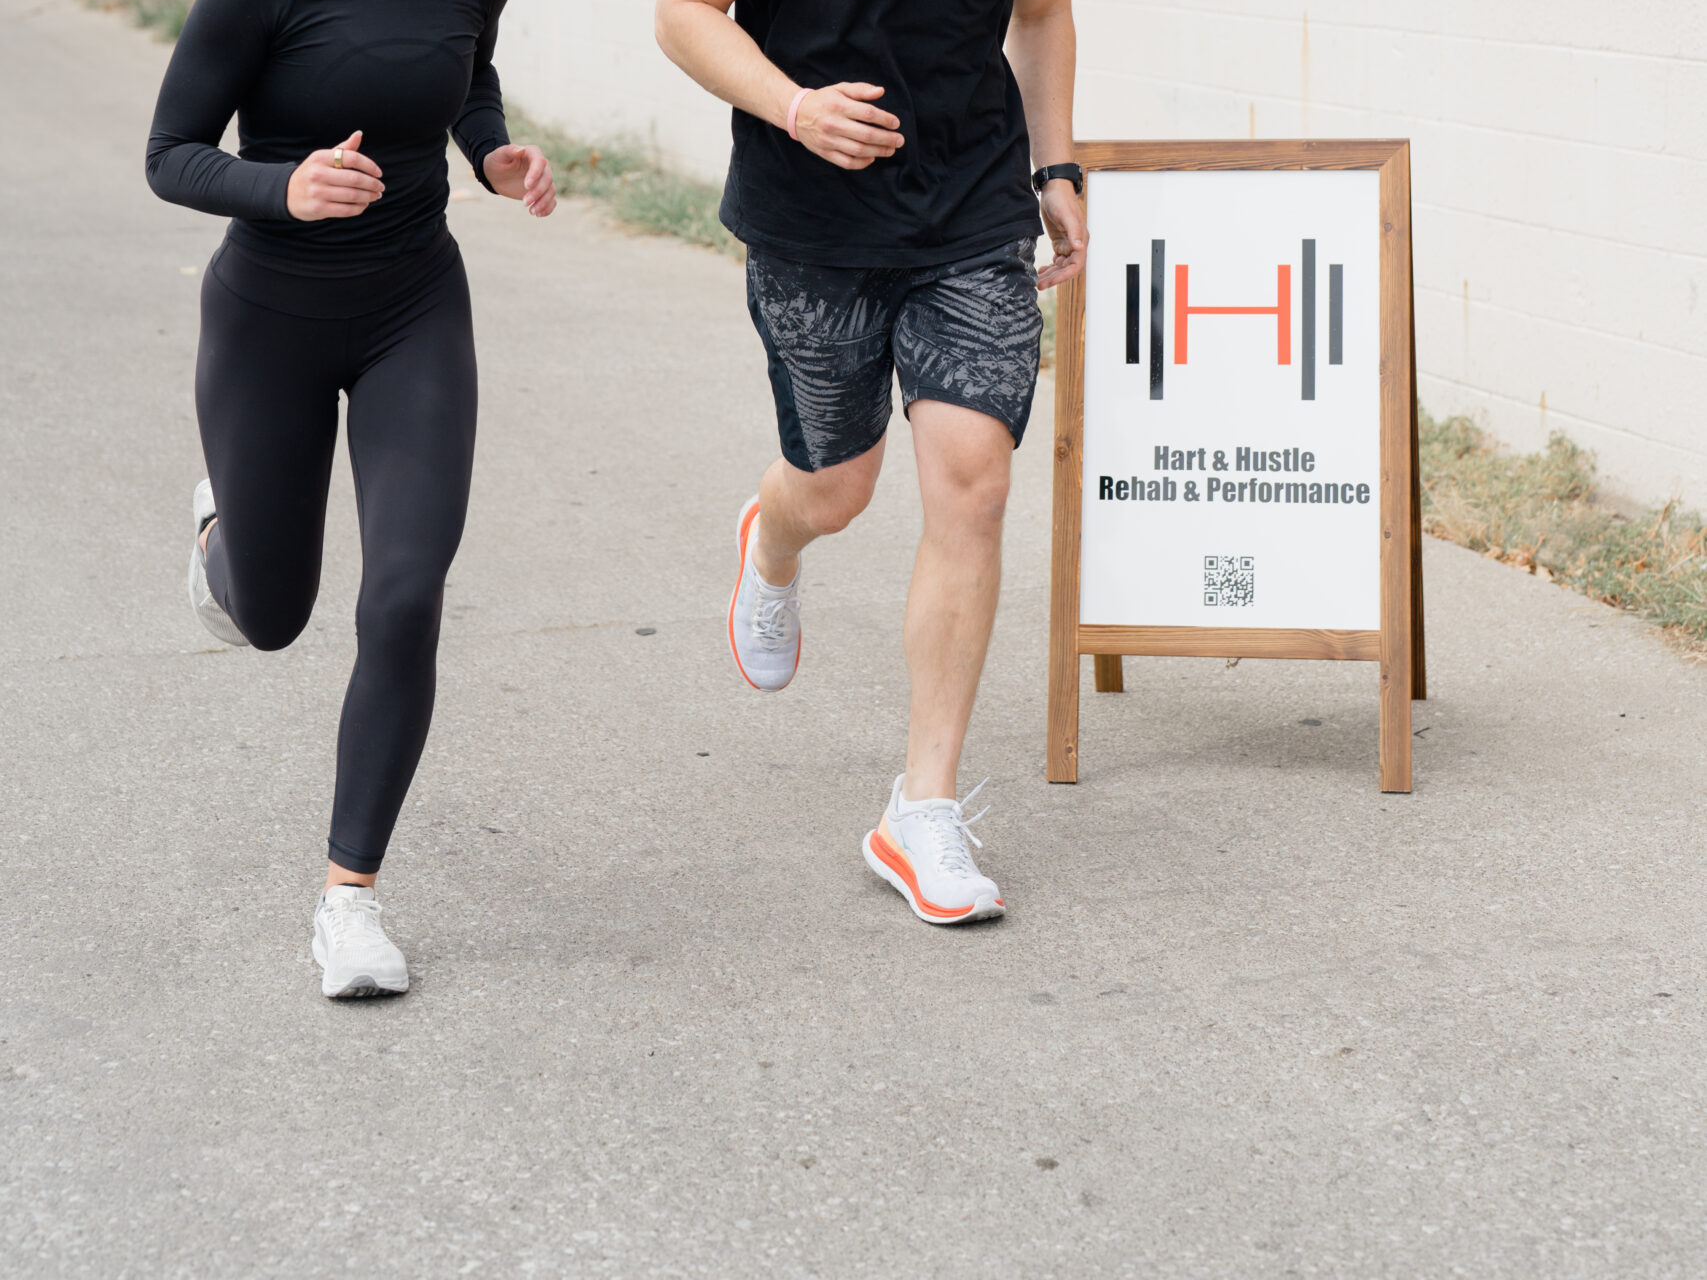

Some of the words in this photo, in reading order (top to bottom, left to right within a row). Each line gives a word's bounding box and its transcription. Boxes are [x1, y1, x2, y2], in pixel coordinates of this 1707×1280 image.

[1153, 445, 1207, 471] Hart
[1211, 449, 1230, 471] &
[1235, 446, 1316, 473] Hustle
[1098, 475, 1178, 501] Rehab
[1183, 480, 1201, 502] &
[1206, 477, 1371, 504] Performance
